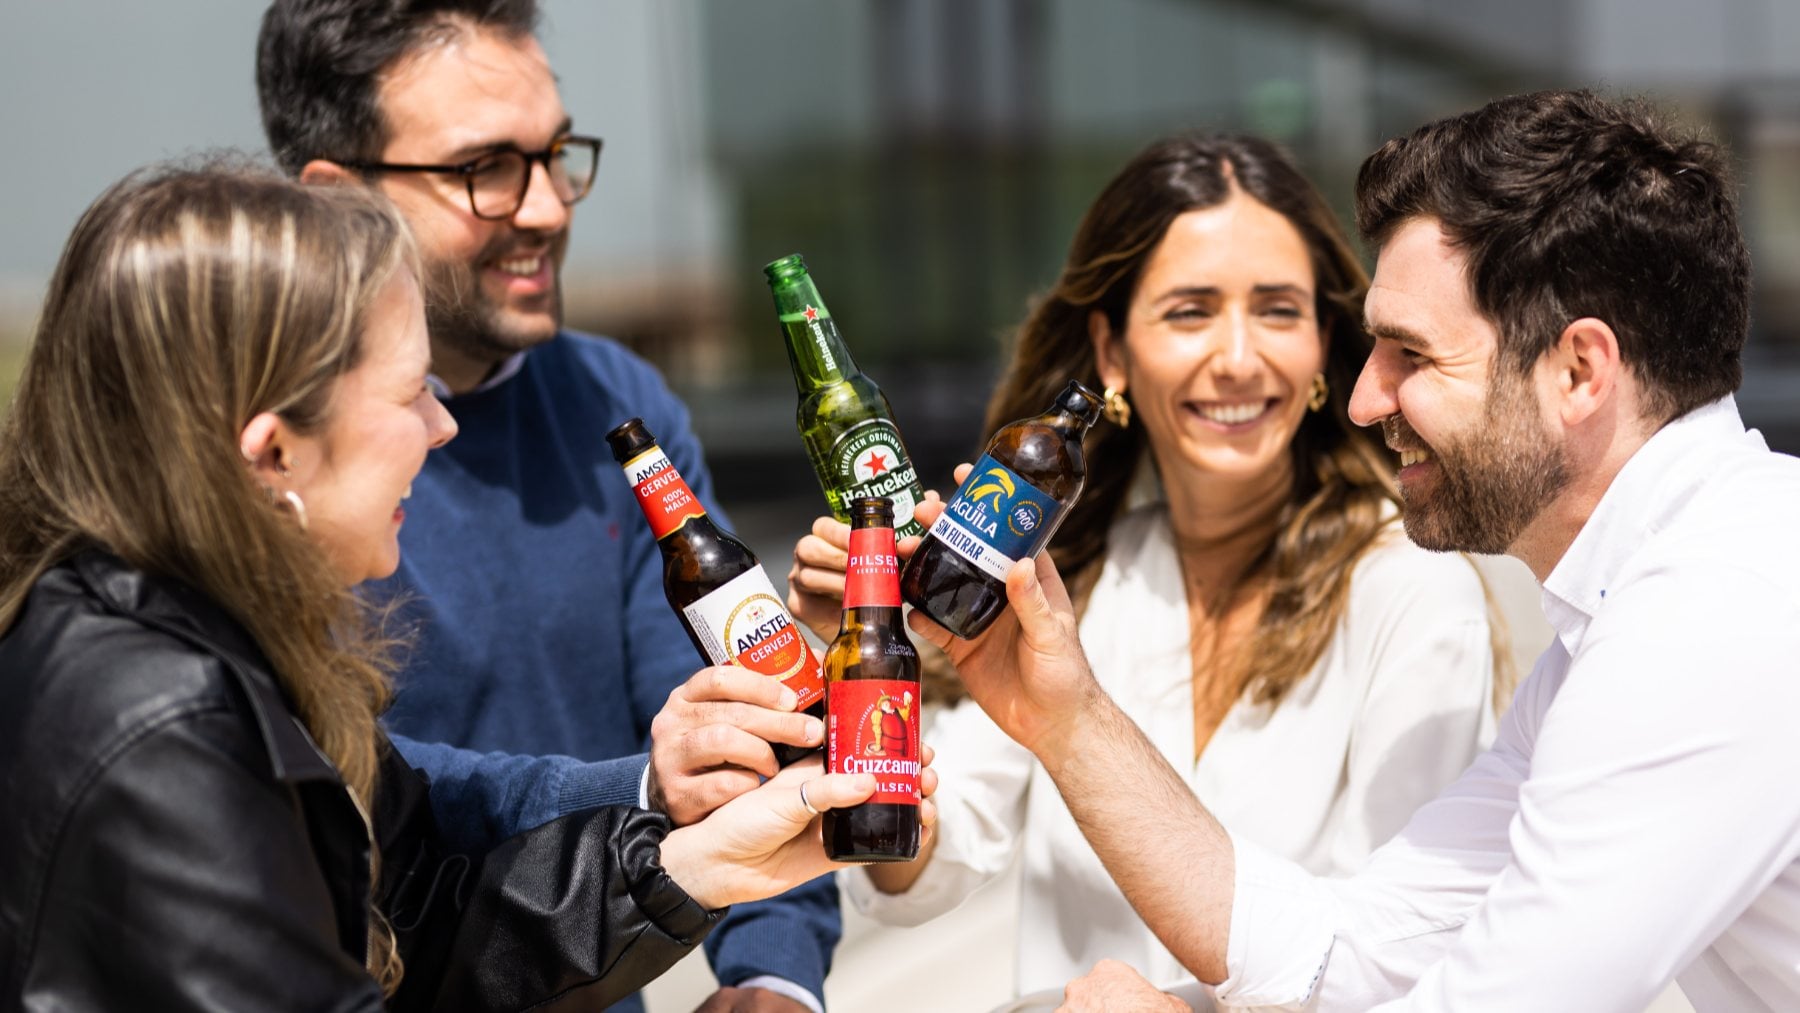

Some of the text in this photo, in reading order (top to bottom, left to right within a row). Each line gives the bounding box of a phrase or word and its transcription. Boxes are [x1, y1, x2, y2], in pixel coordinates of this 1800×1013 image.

[812, 322, 837, 372] Heineken
[842, 438, 867, 476] HEINEKEN
[869, 432, 901, 453] ORIGINAL
[662, 488, 684, 504] 100%
[665, 495, 691, 514] MALTA
[977, 501, 987, 513] EL
[1014, 507, 1035, 531] 1900
[935, 519, 951, 537] SIN
[946, 527, 985, 561] FILTRAR
[737, 613, 791, 654] AMSTEL
[750, 631, 795, 663] CERVEZA
[876, 782, 912, 793] ILSEN
